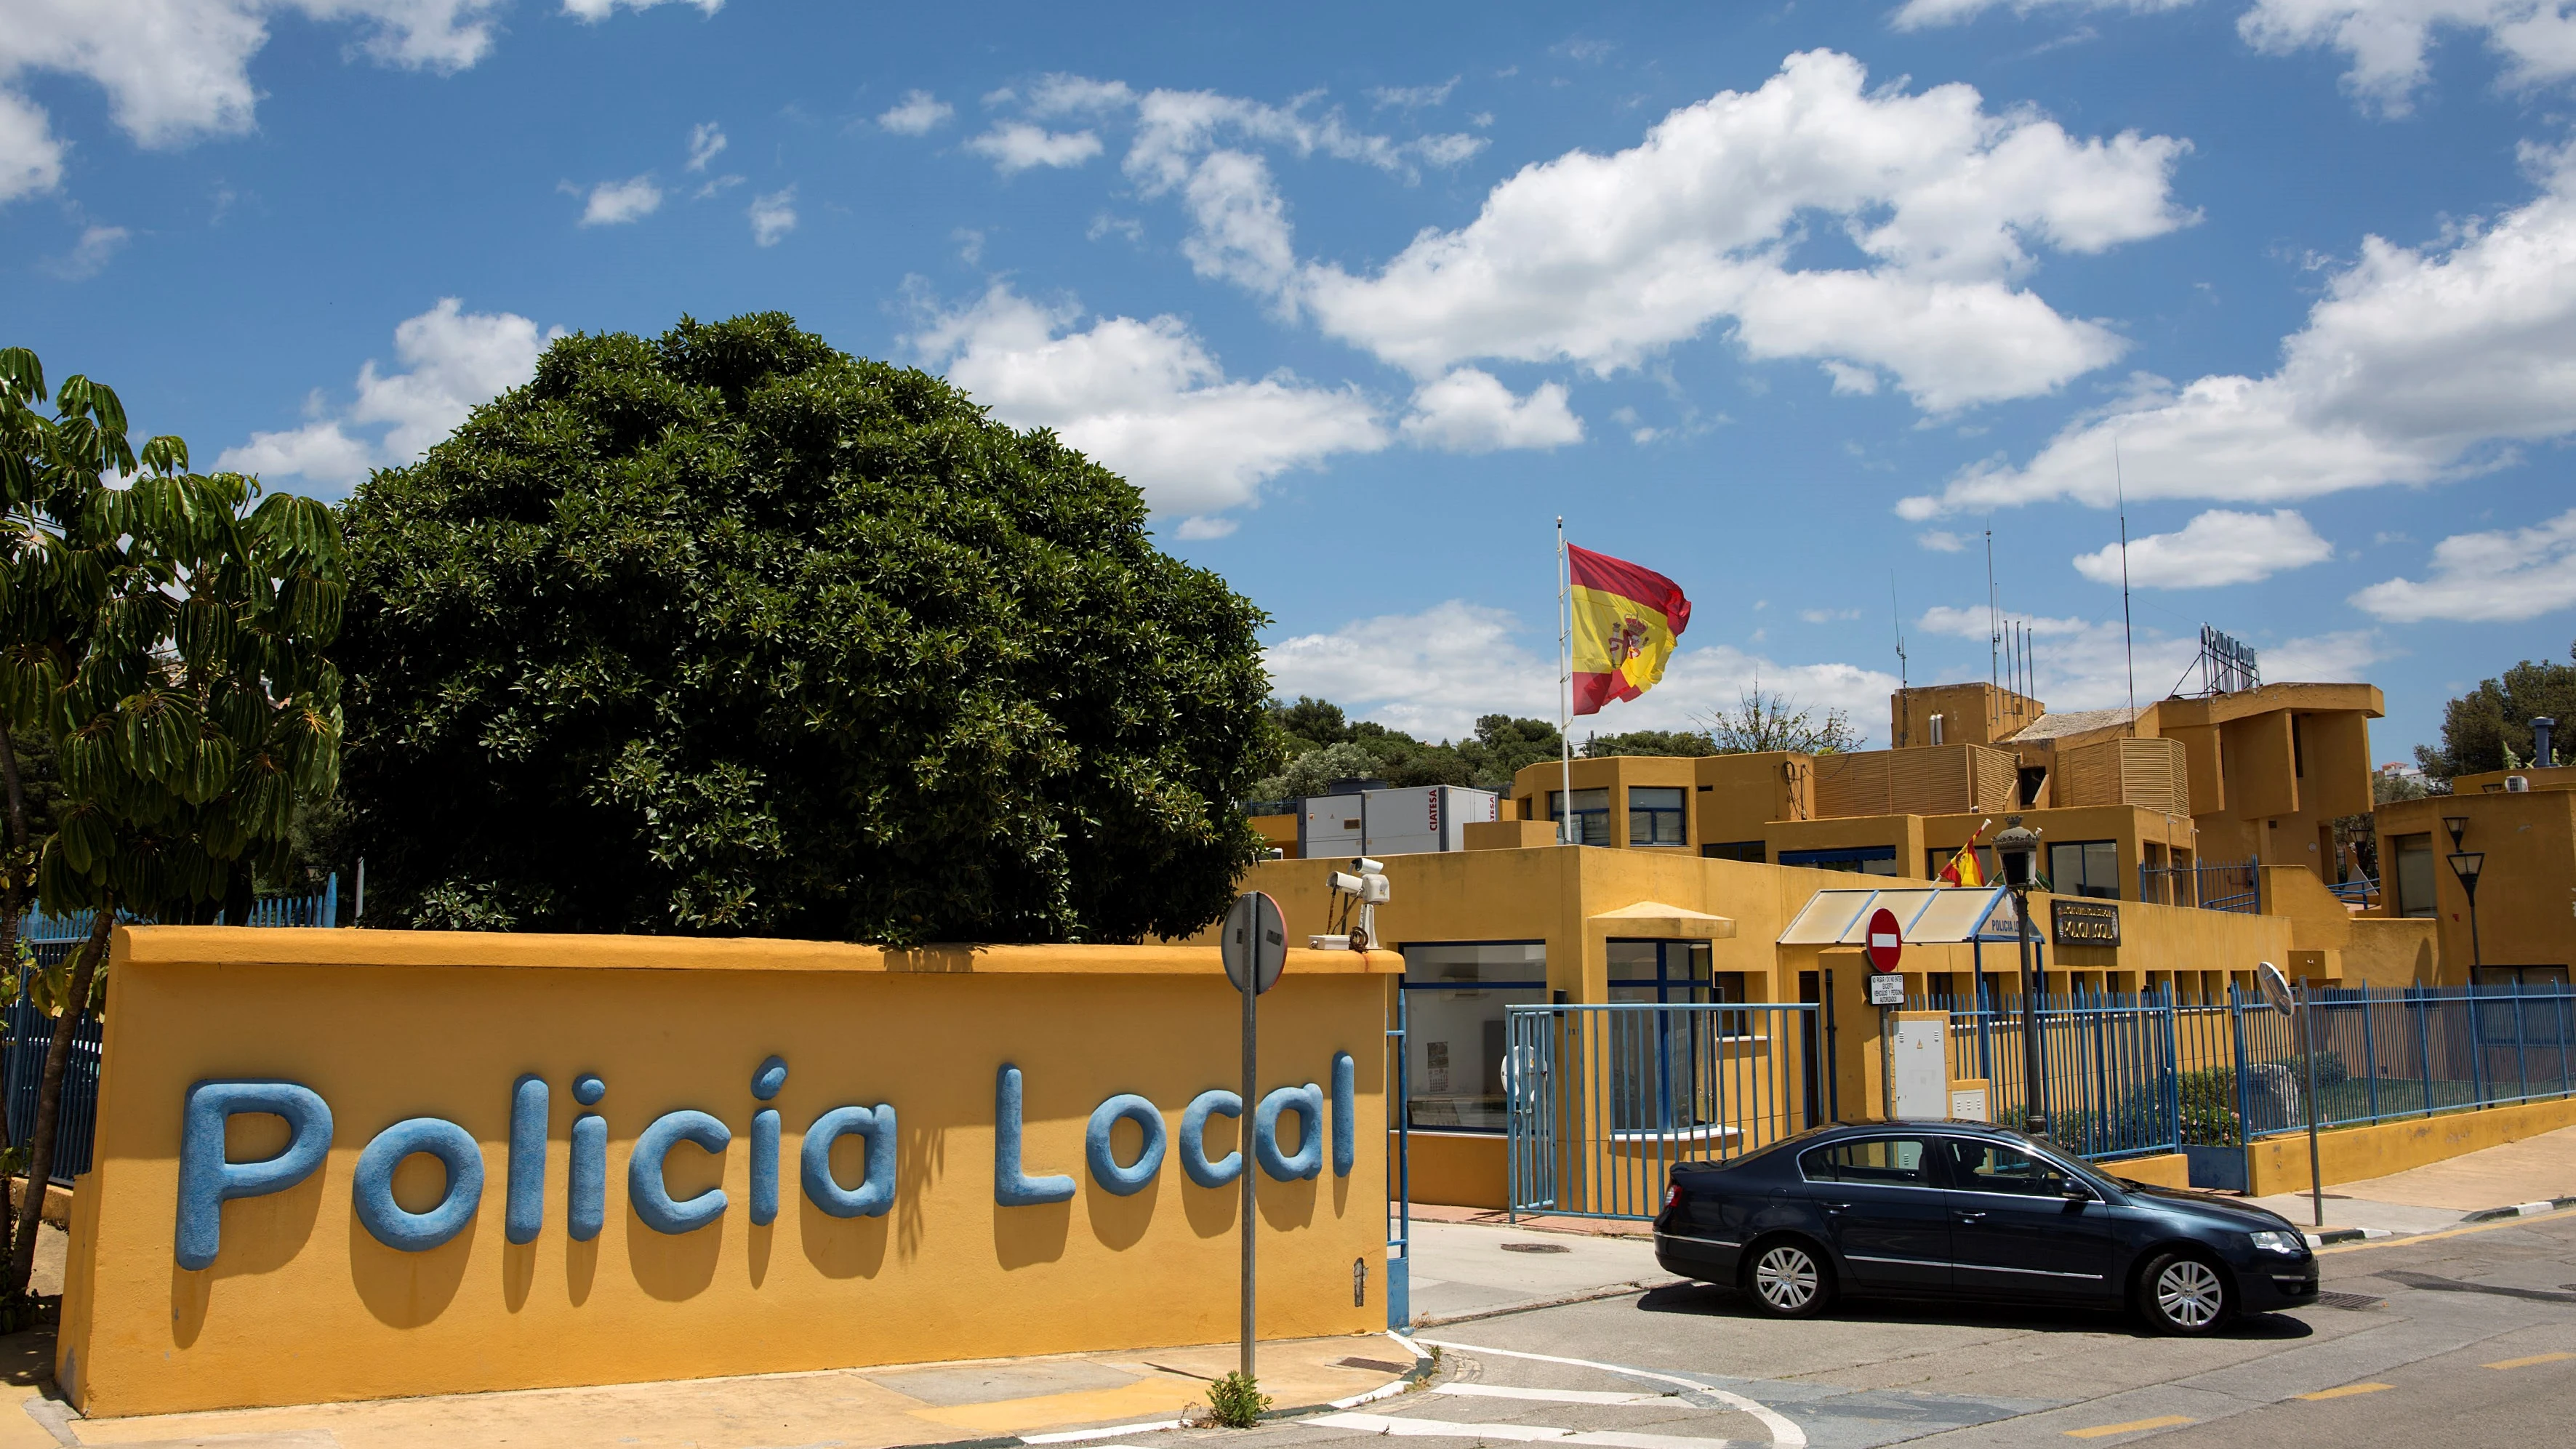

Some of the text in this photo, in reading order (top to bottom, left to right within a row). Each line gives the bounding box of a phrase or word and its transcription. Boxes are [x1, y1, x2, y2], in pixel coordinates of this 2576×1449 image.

[1429, 789, 1437, 831] CIATESA
[1991, 919, 2013, 931] POLICIA
[2063, 920, 2090, 939] POLICIA
[994, 1051, 1355, 1207] Local
